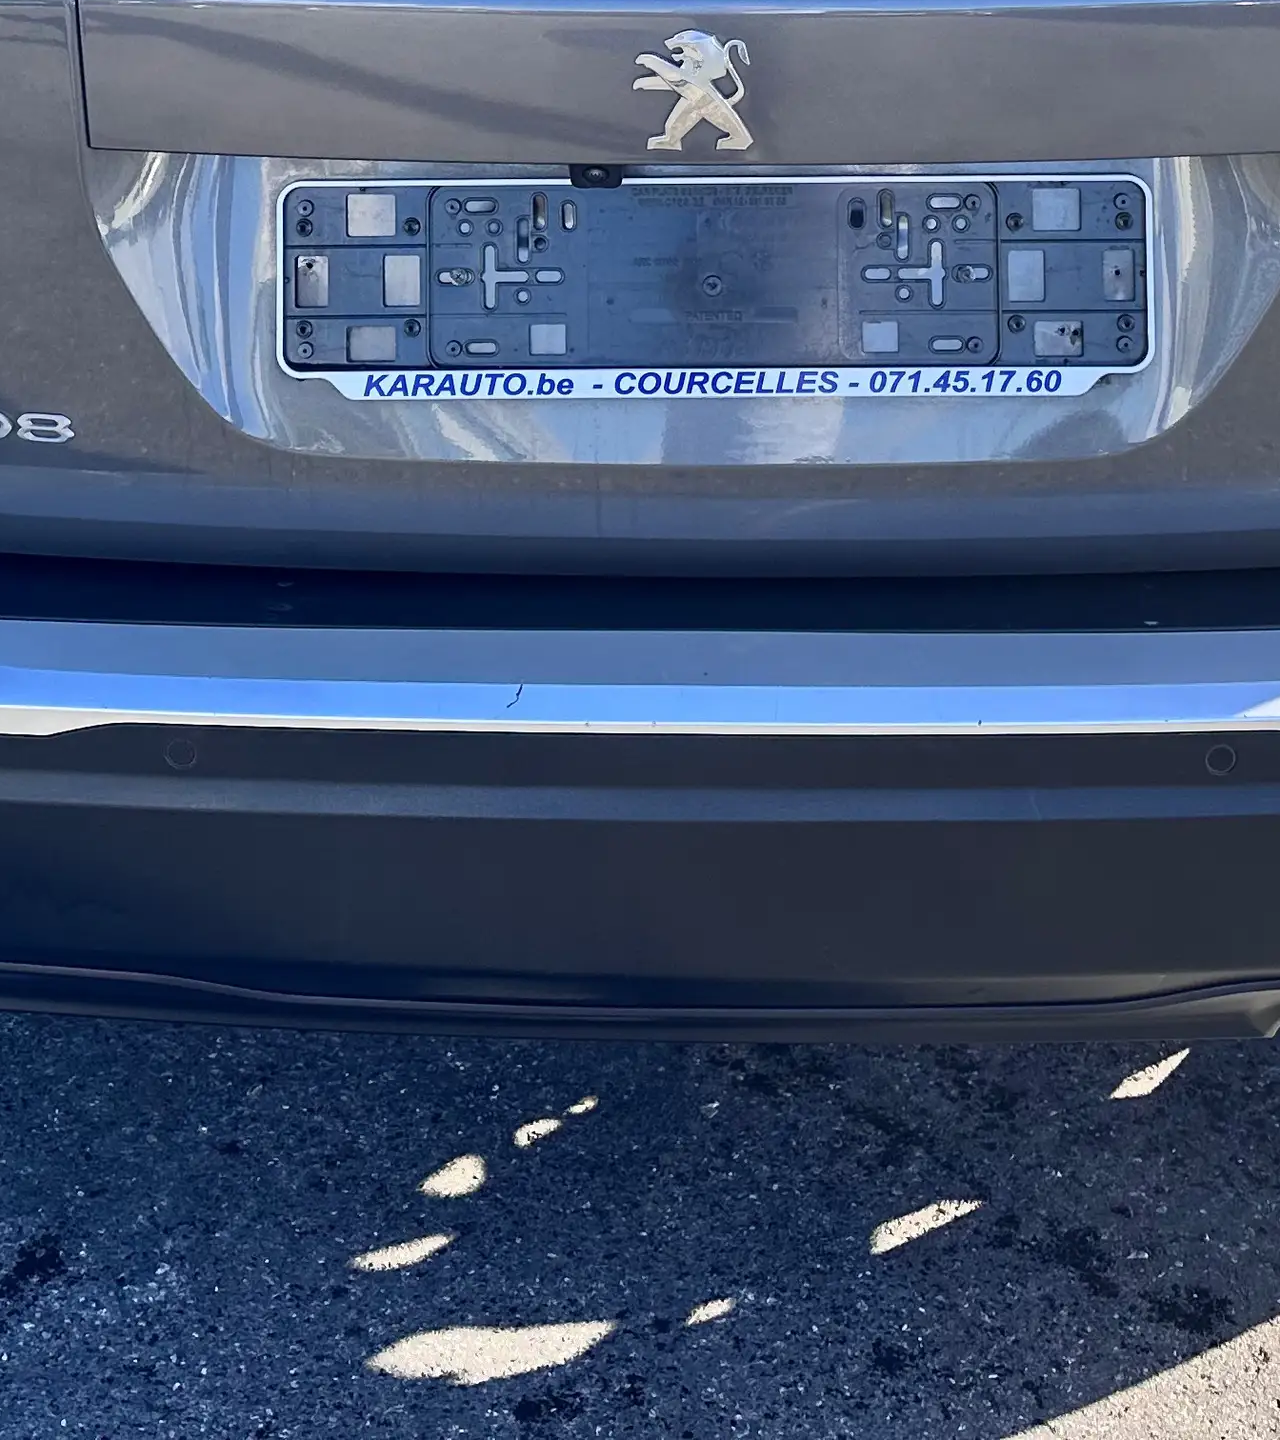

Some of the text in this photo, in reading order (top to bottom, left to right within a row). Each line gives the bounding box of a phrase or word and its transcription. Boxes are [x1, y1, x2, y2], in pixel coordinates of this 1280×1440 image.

[363, 372, 575, 398] KARAUTO.be
[614, 371, 839, 396] COURCELLES
[869, 369, 1063, 394] 071.45.17.60
